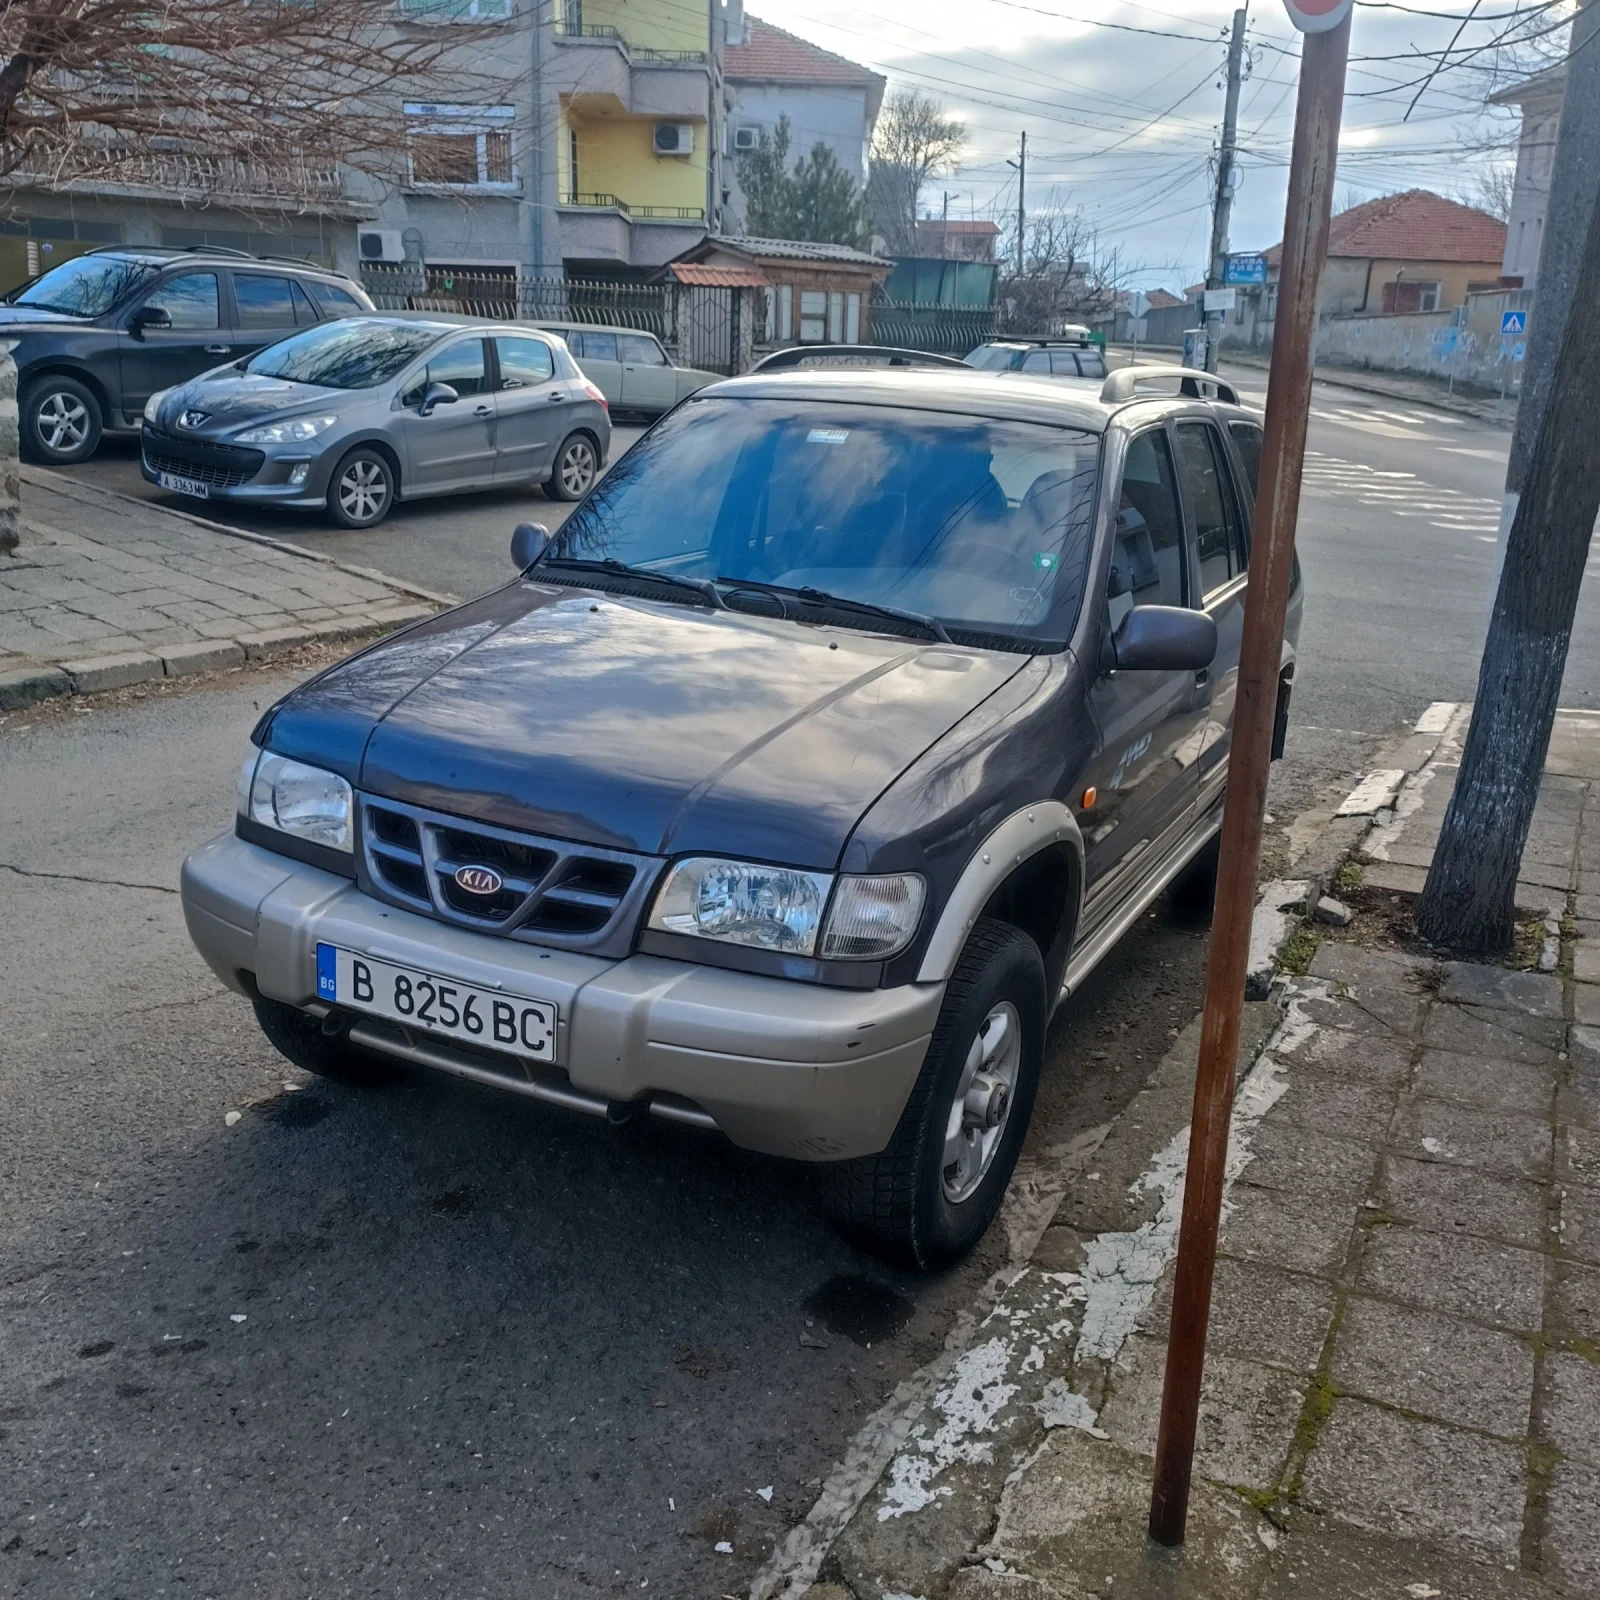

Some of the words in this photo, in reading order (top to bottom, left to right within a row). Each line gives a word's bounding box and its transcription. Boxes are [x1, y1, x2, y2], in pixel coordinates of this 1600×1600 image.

[173, 477, 193, 493] 3363
[194, 483, 207, 496] MM
[462, 869, 493, 890] KIA
[320, 977, 335, 991] BG
[353, 960, 374, 1002] B
[394, 975, 483, 1034] 8256
[493, 1000, 545, 1051] BC
